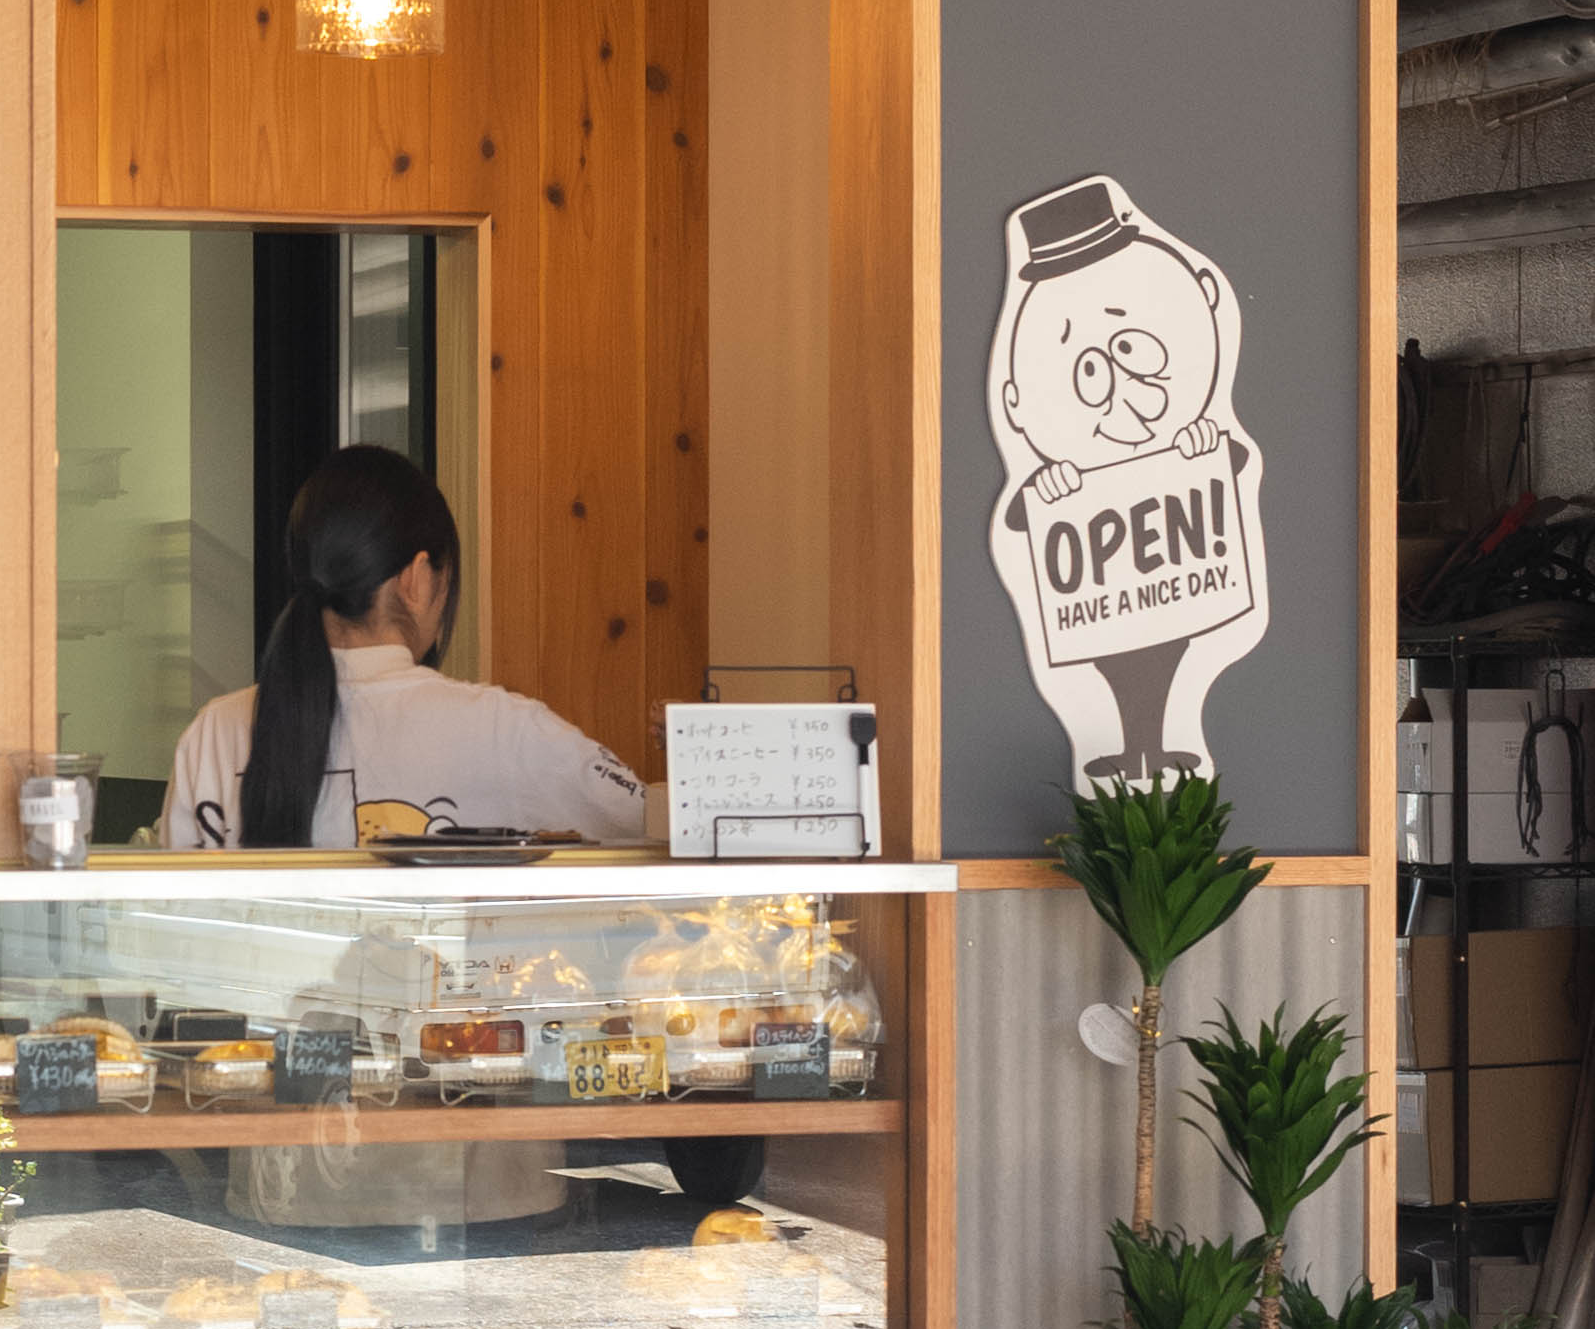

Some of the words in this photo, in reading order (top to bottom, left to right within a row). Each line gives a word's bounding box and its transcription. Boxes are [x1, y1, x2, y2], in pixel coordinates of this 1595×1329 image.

[1045, 478, 1227, 594] OPEN!
[1057, 595, 1110, 631] HAVE
[1117, 590, 1133, 616] A
[1137, 577, 1181, 610] NICE
[1187, 565, 1237, 597] DAY.
